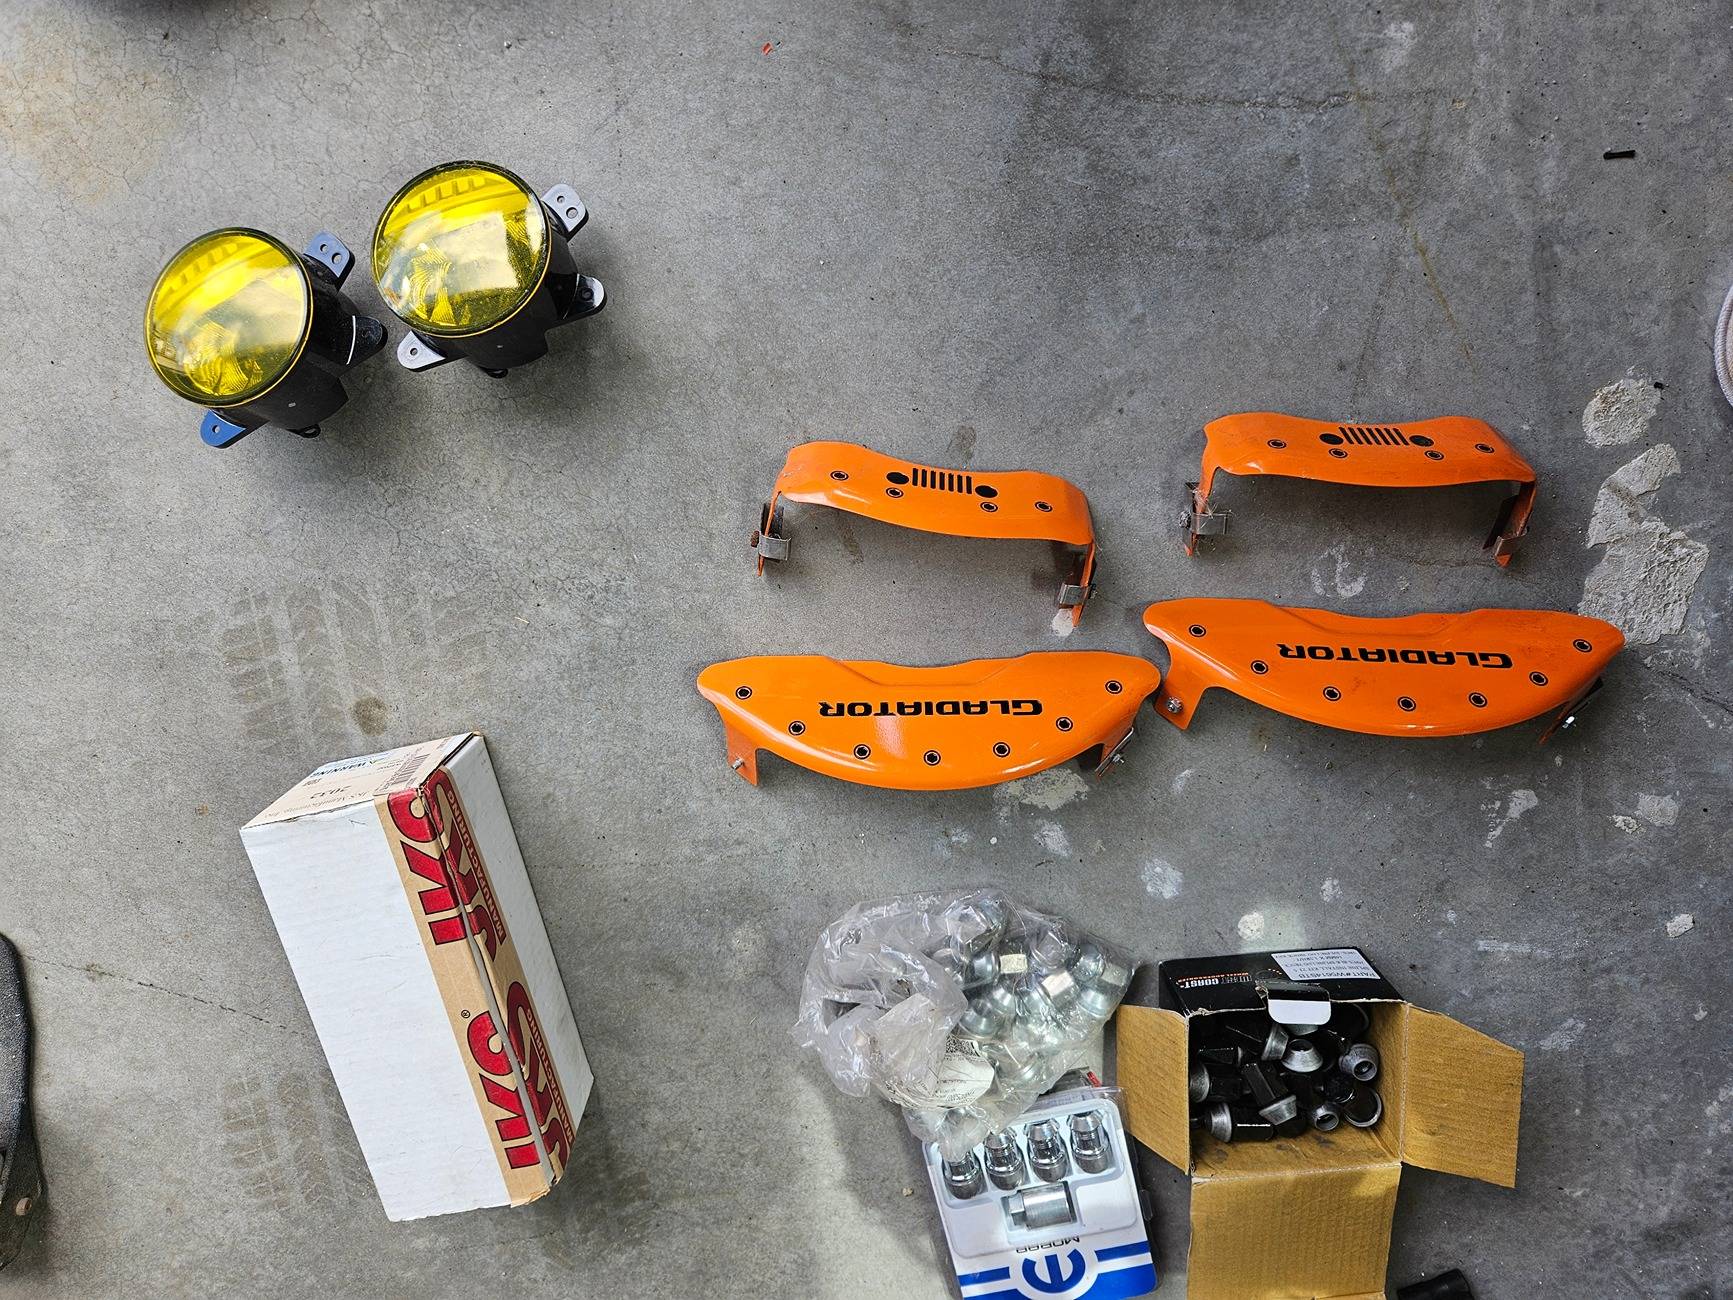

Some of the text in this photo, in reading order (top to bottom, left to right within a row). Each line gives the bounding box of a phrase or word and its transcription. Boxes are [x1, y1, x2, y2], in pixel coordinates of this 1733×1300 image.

[1276, 643, 1513, 669] GLADIATOR
[818, 699, 1043, 717] GLADIATOR
[448, 790, 504, 941] MANUFACTURING
[1184, 978, 1219, 989] COAST
[526, 1008, 575, 1146] MANUFACTURING
